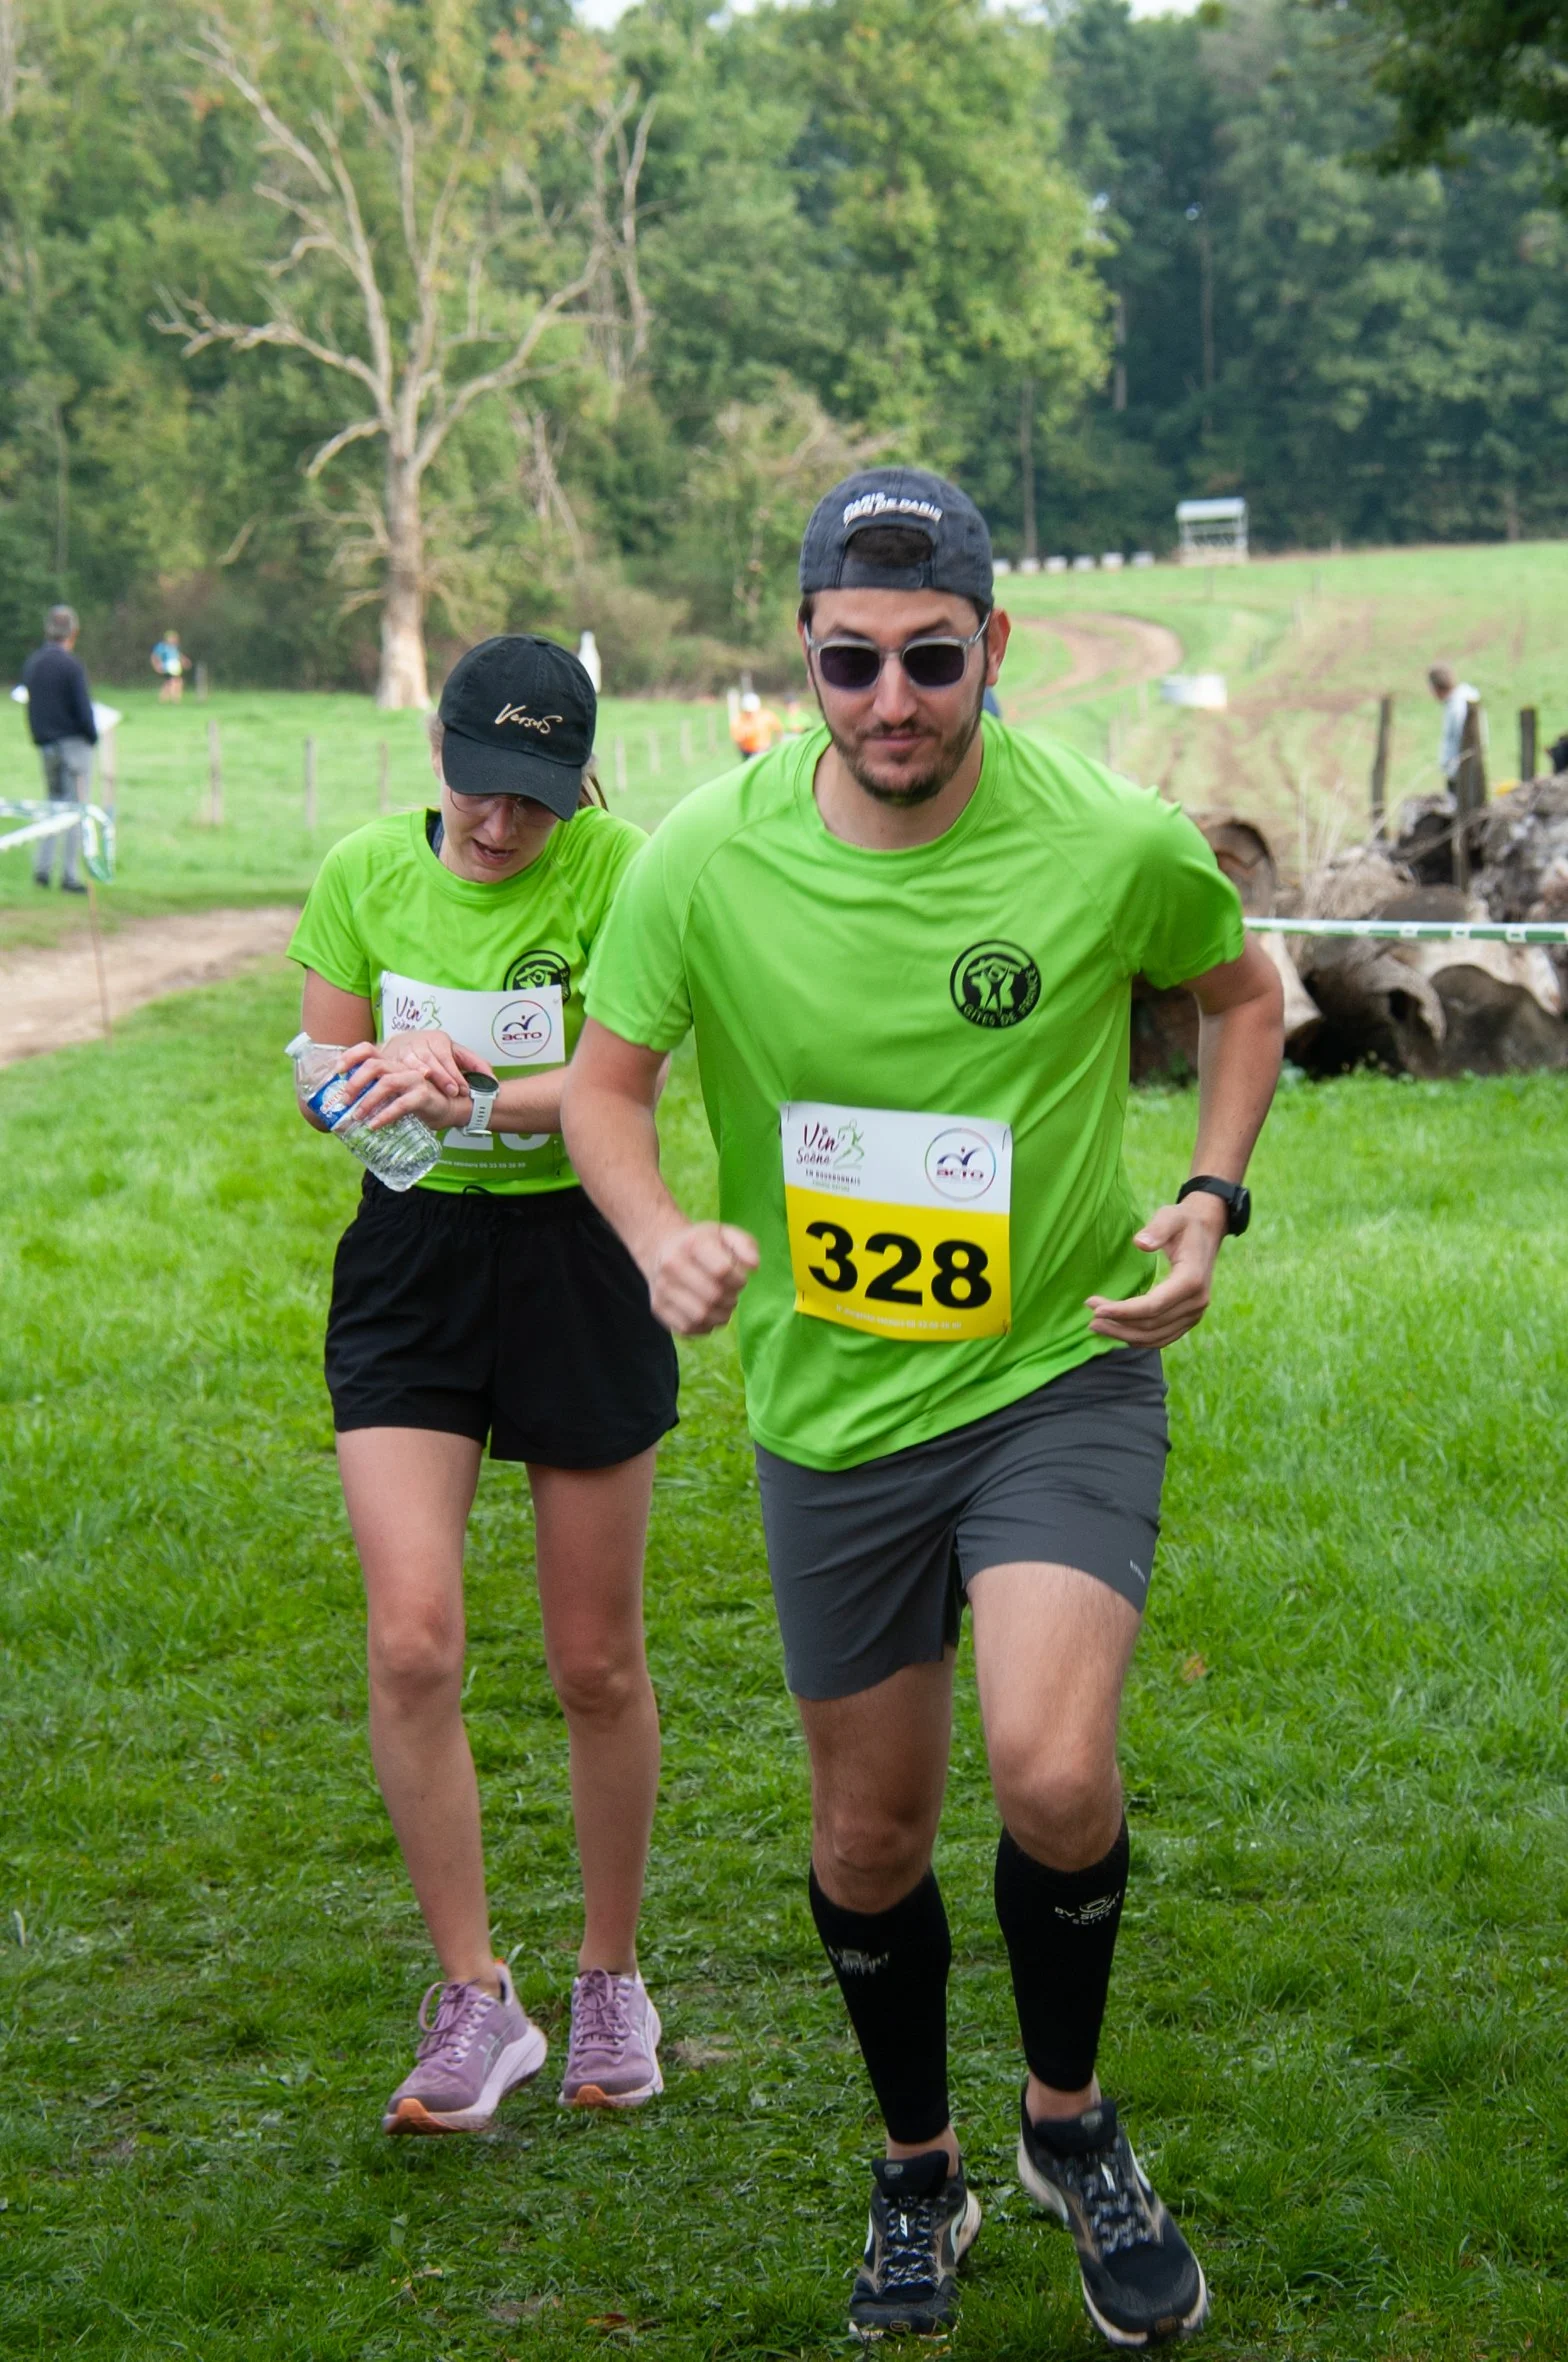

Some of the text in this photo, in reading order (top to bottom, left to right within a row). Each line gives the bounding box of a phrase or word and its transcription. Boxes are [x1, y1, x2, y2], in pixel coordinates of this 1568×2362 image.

[396, 996, 423, 1020] Vin
[804, 1121, 839, 1152] Vin
[805, 1220, 992, 1310] 328
